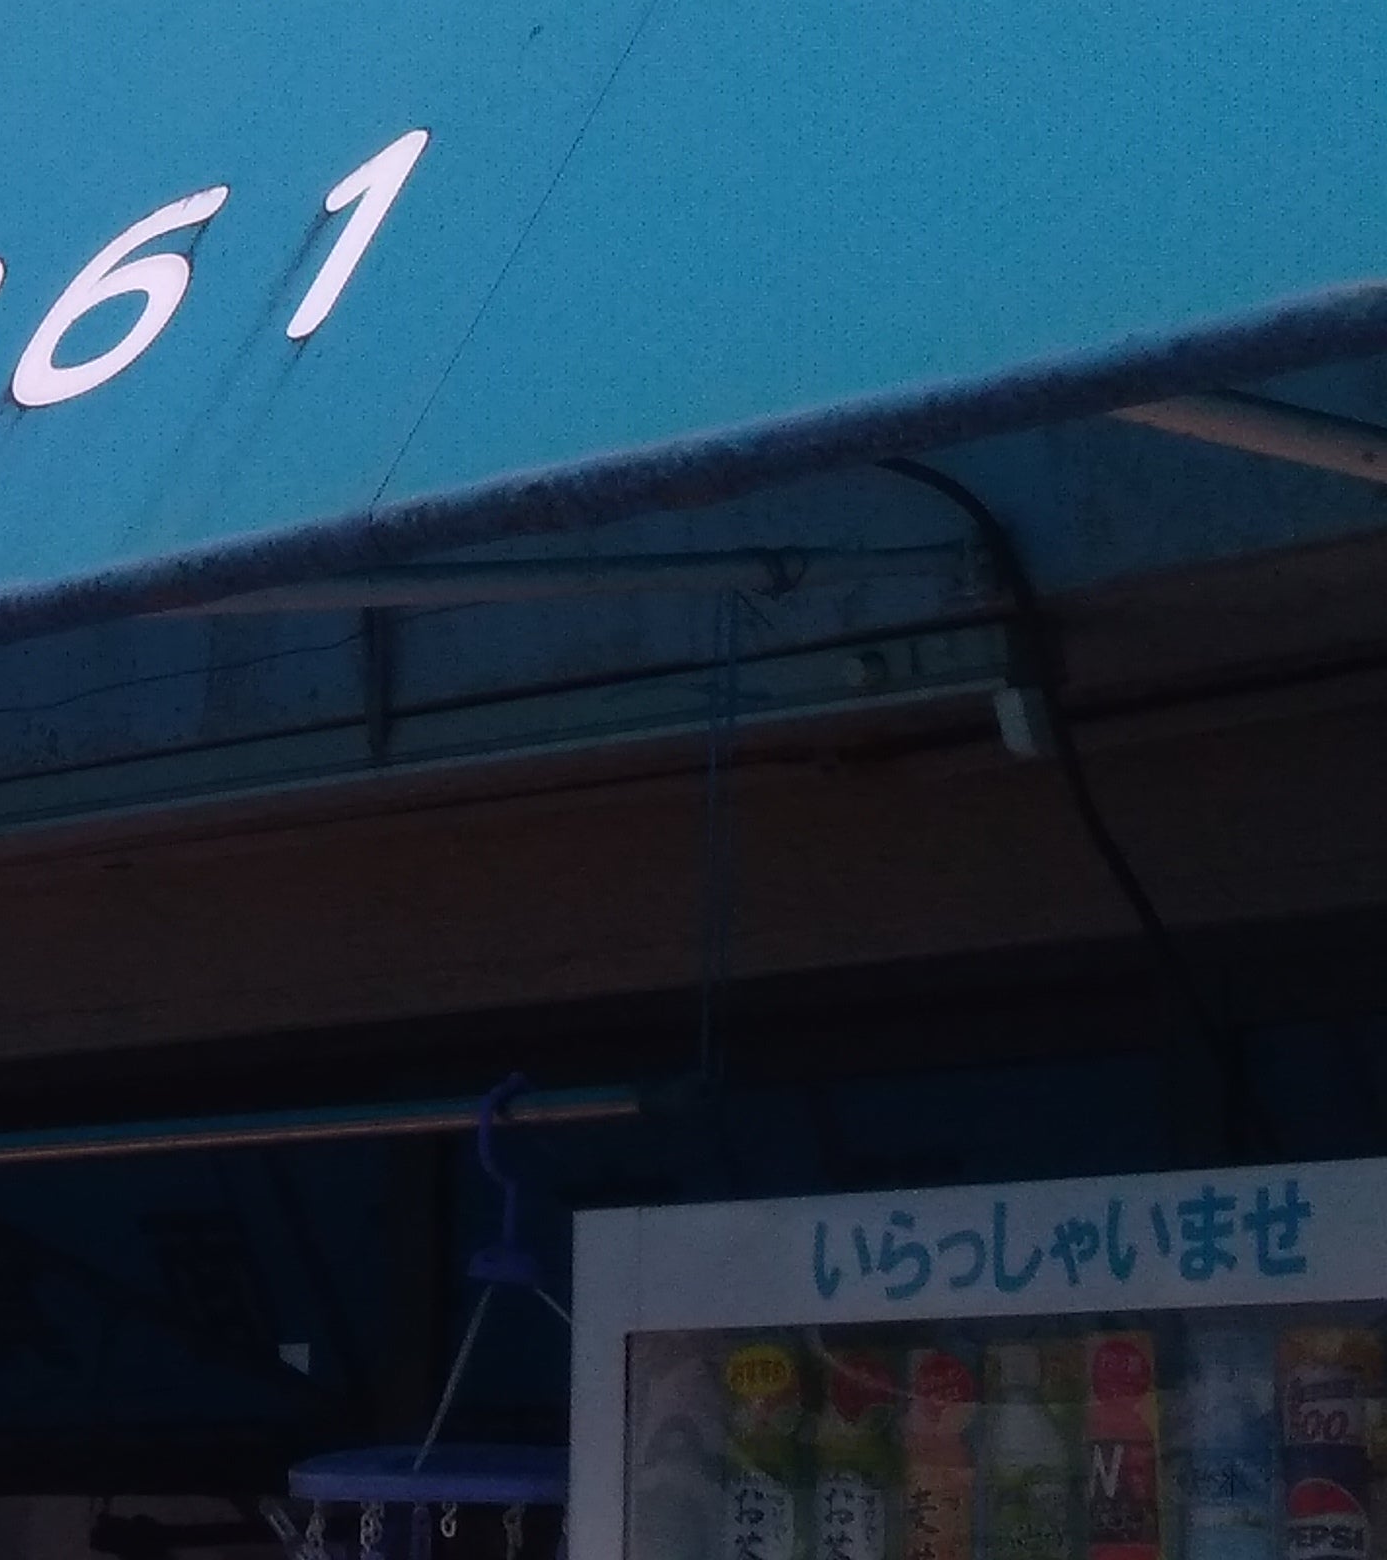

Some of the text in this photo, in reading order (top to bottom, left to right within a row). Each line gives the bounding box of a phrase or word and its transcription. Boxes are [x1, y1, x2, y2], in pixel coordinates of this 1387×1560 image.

[813, 1180, 1313, 1300] いらっしゃいませ
